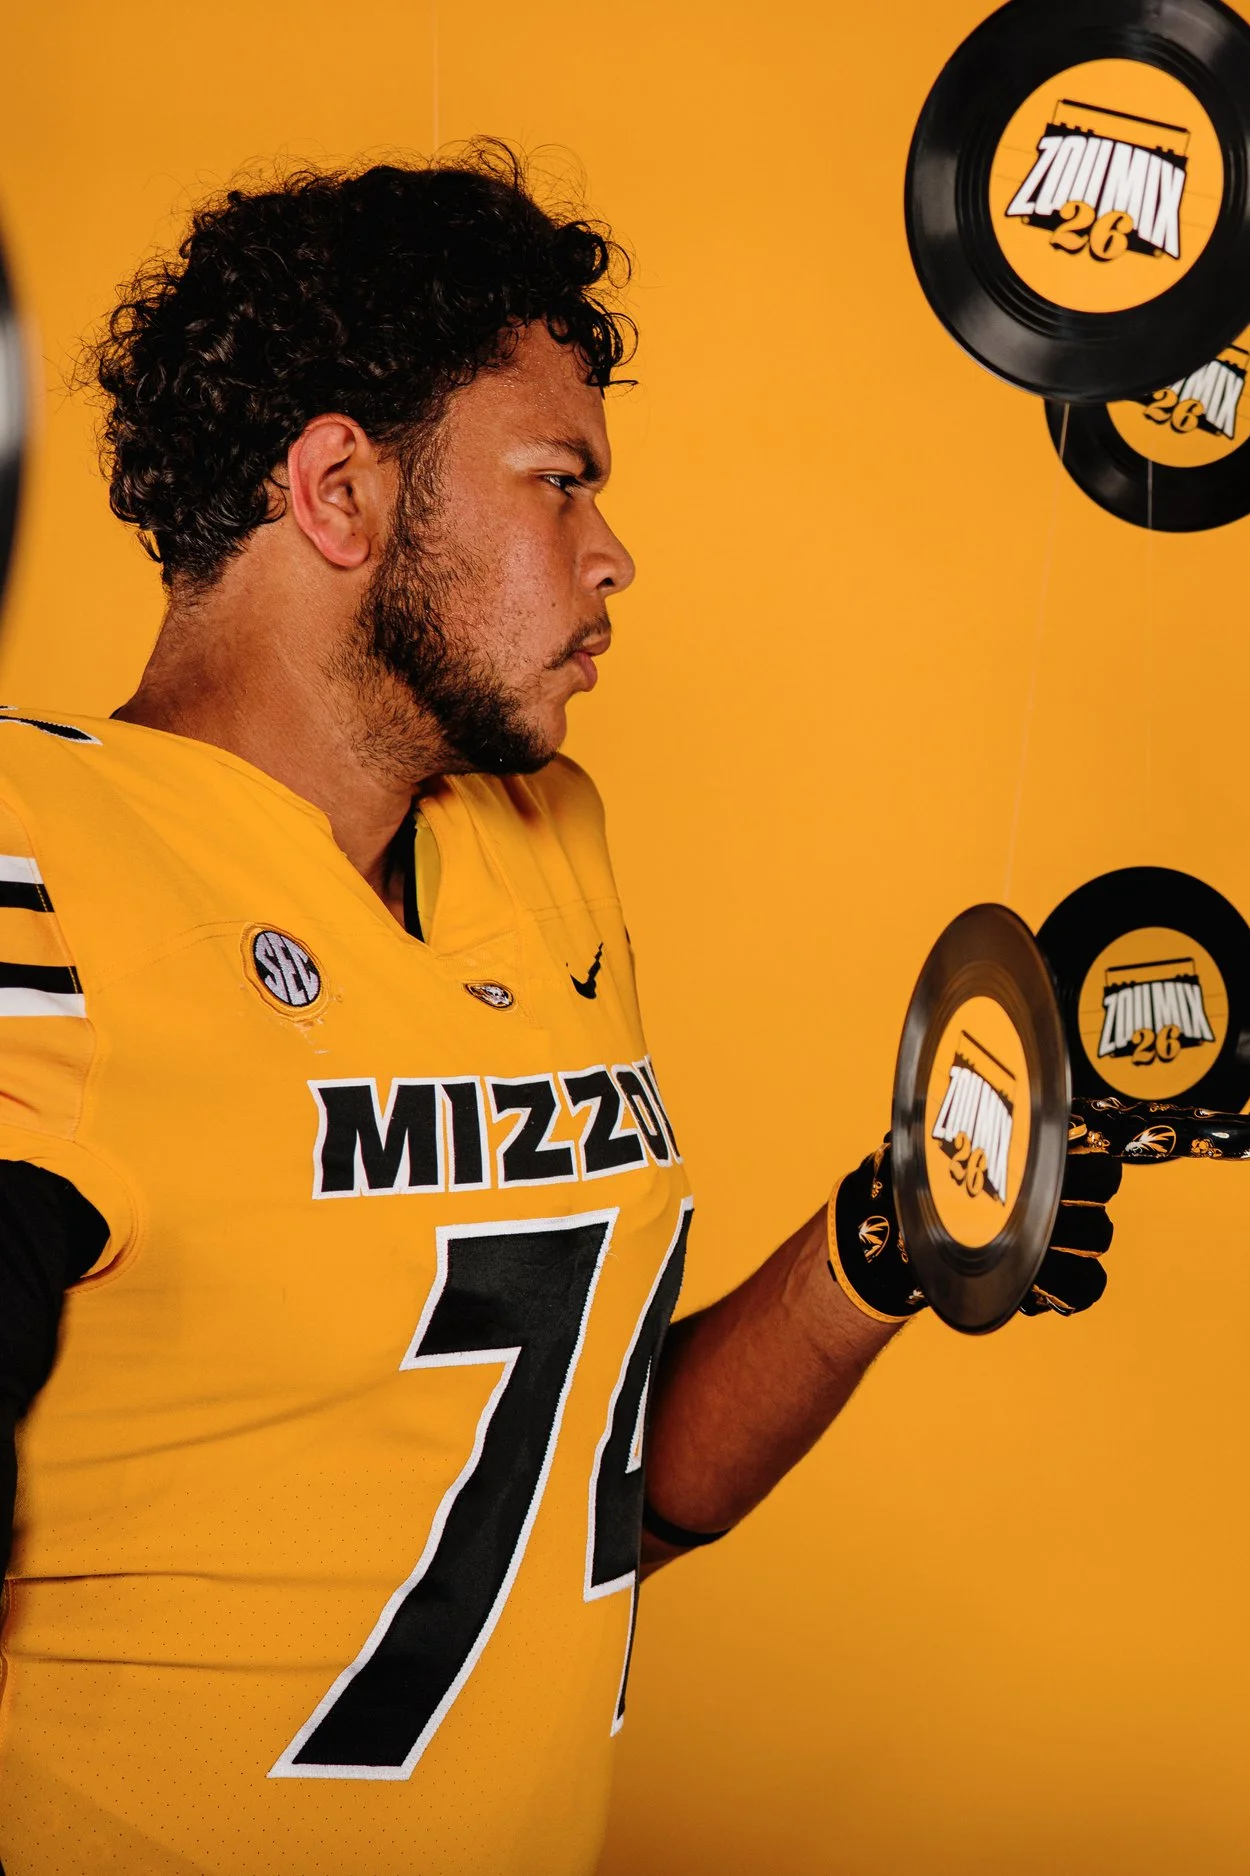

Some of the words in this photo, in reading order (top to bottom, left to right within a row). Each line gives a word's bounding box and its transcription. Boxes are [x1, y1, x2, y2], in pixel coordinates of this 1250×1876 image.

[1050, 200, 1134, 263] 26
[1143, 388, 1205, 434] 26
[254, 931, 321, 1007] SEC
[1131, 1024, 1181, 1067] 26
[949, 1131, 987, 1199] 26
